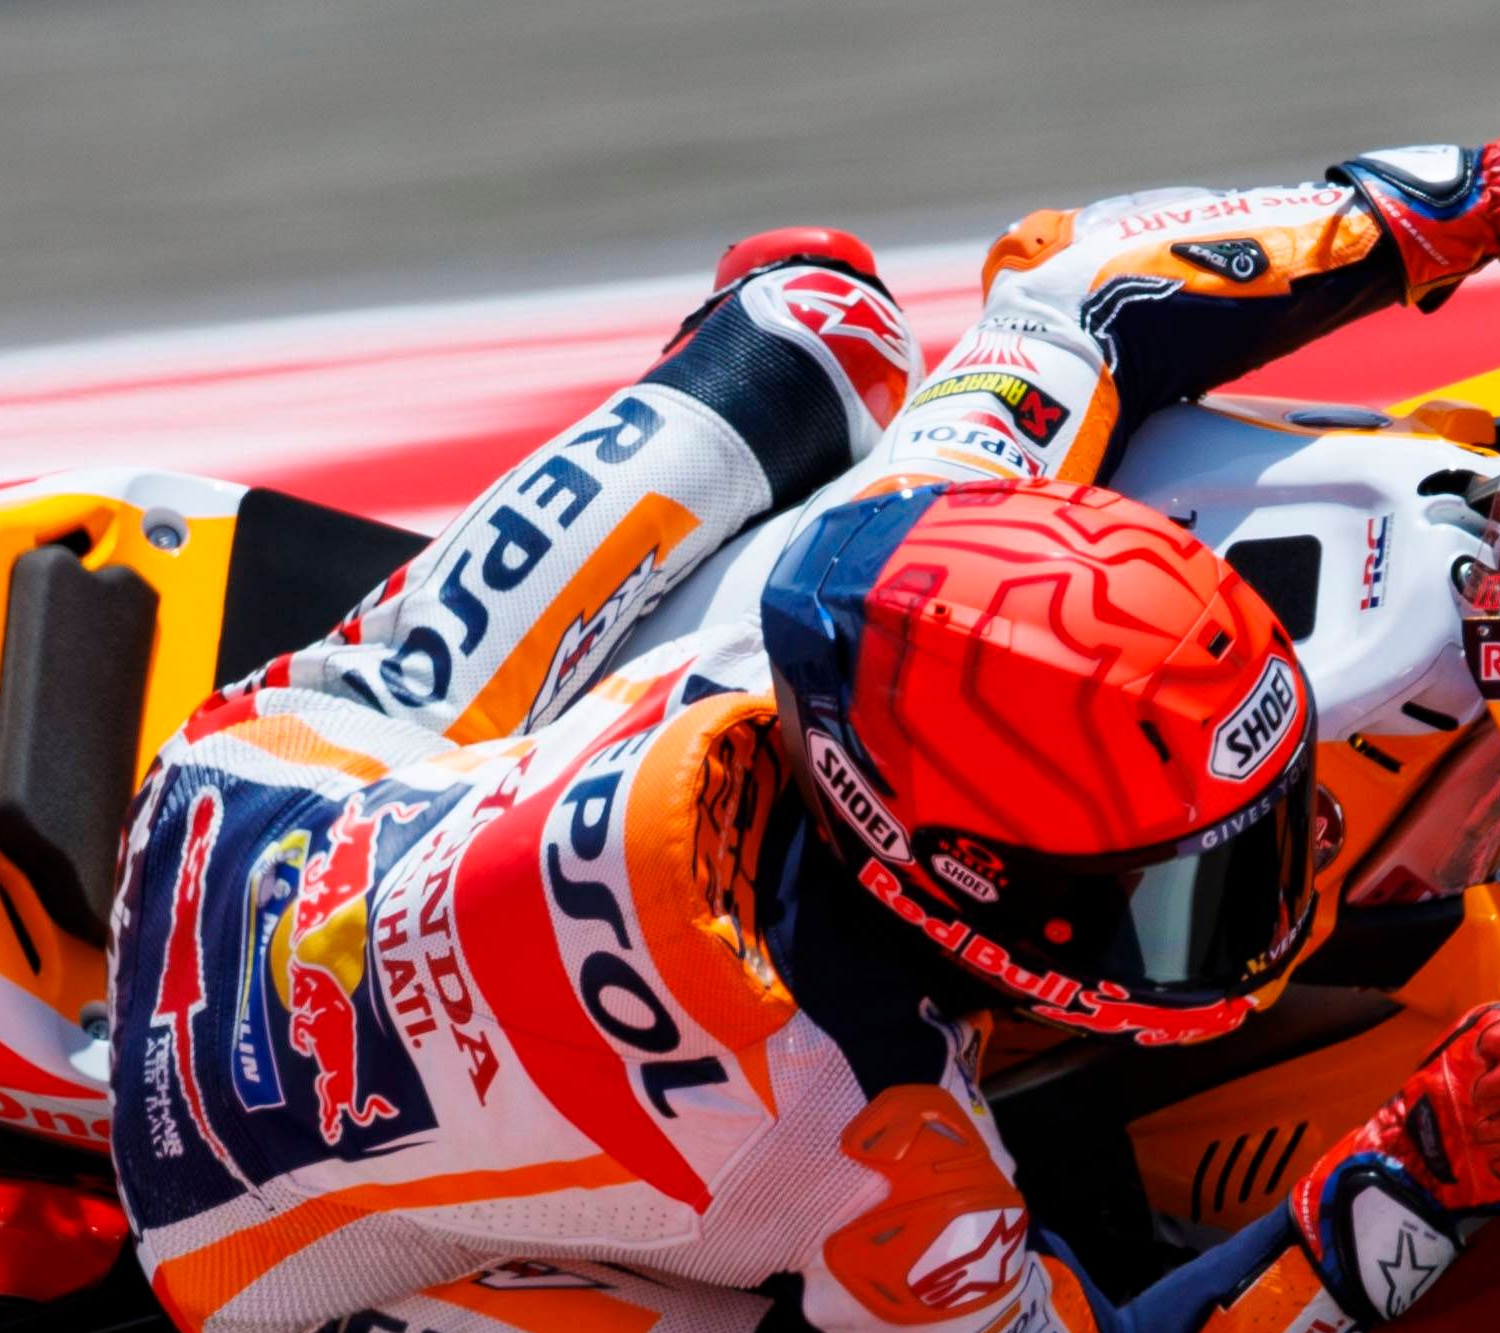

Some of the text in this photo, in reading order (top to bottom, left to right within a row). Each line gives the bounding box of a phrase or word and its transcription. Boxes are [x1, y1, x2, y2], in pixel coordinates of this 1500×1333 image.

[1117, 186, 1343, 240] One HEART
[910, 371, 1028, 412] AKRAPOVI
[910, 425, 1036, 478] EPSOL
[1360, 516, 1388, 611] HRC
[816, 748, 899, 852] SHOEI
[1202, 798, 1272, 850] GIVES
[942, 859, 991, 898] SHOEI
[858, 857, 1083, 1008] Red Bull
[376, 908, 438, 1050] HATI.
